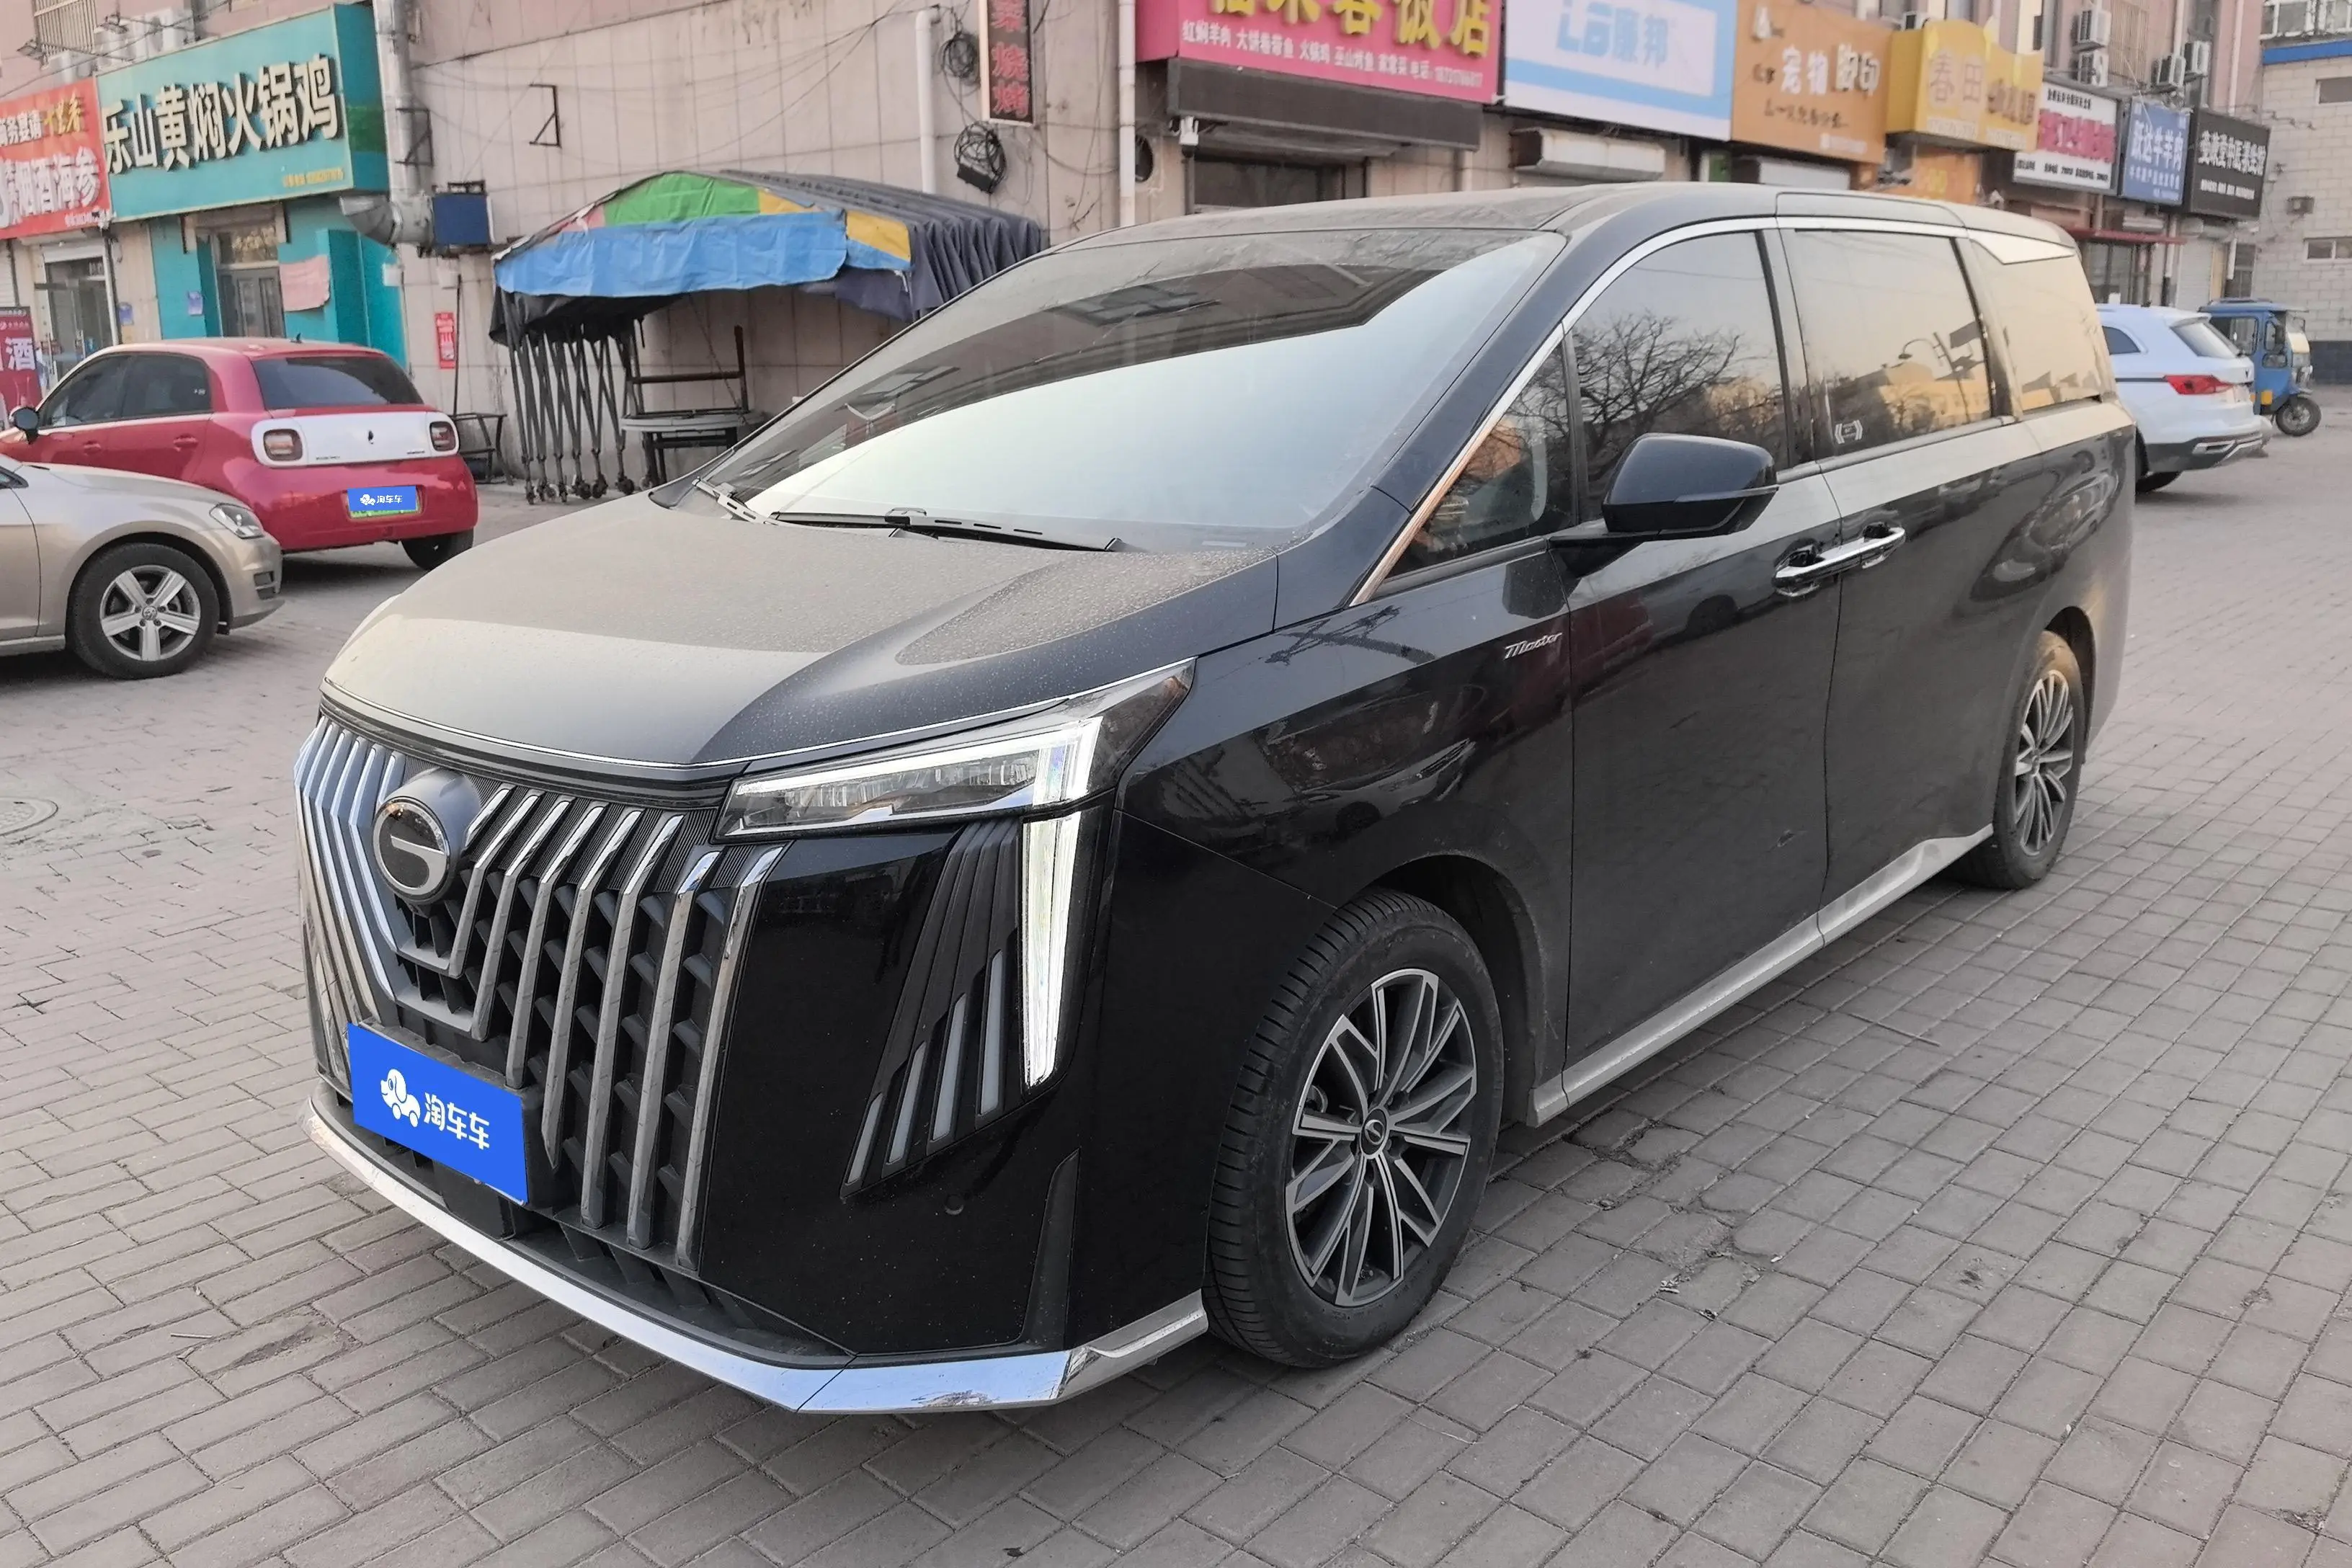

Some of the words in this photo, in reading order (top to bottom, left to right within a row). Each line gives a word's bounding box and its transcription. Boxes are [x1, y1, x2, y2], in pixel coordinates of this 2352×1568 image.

[1208, 0, 1490, 57] 客饭店
[102, 53, 338, 174] 乐山黄焖火锅鸡
[0, 336, 36, 371] 酒
